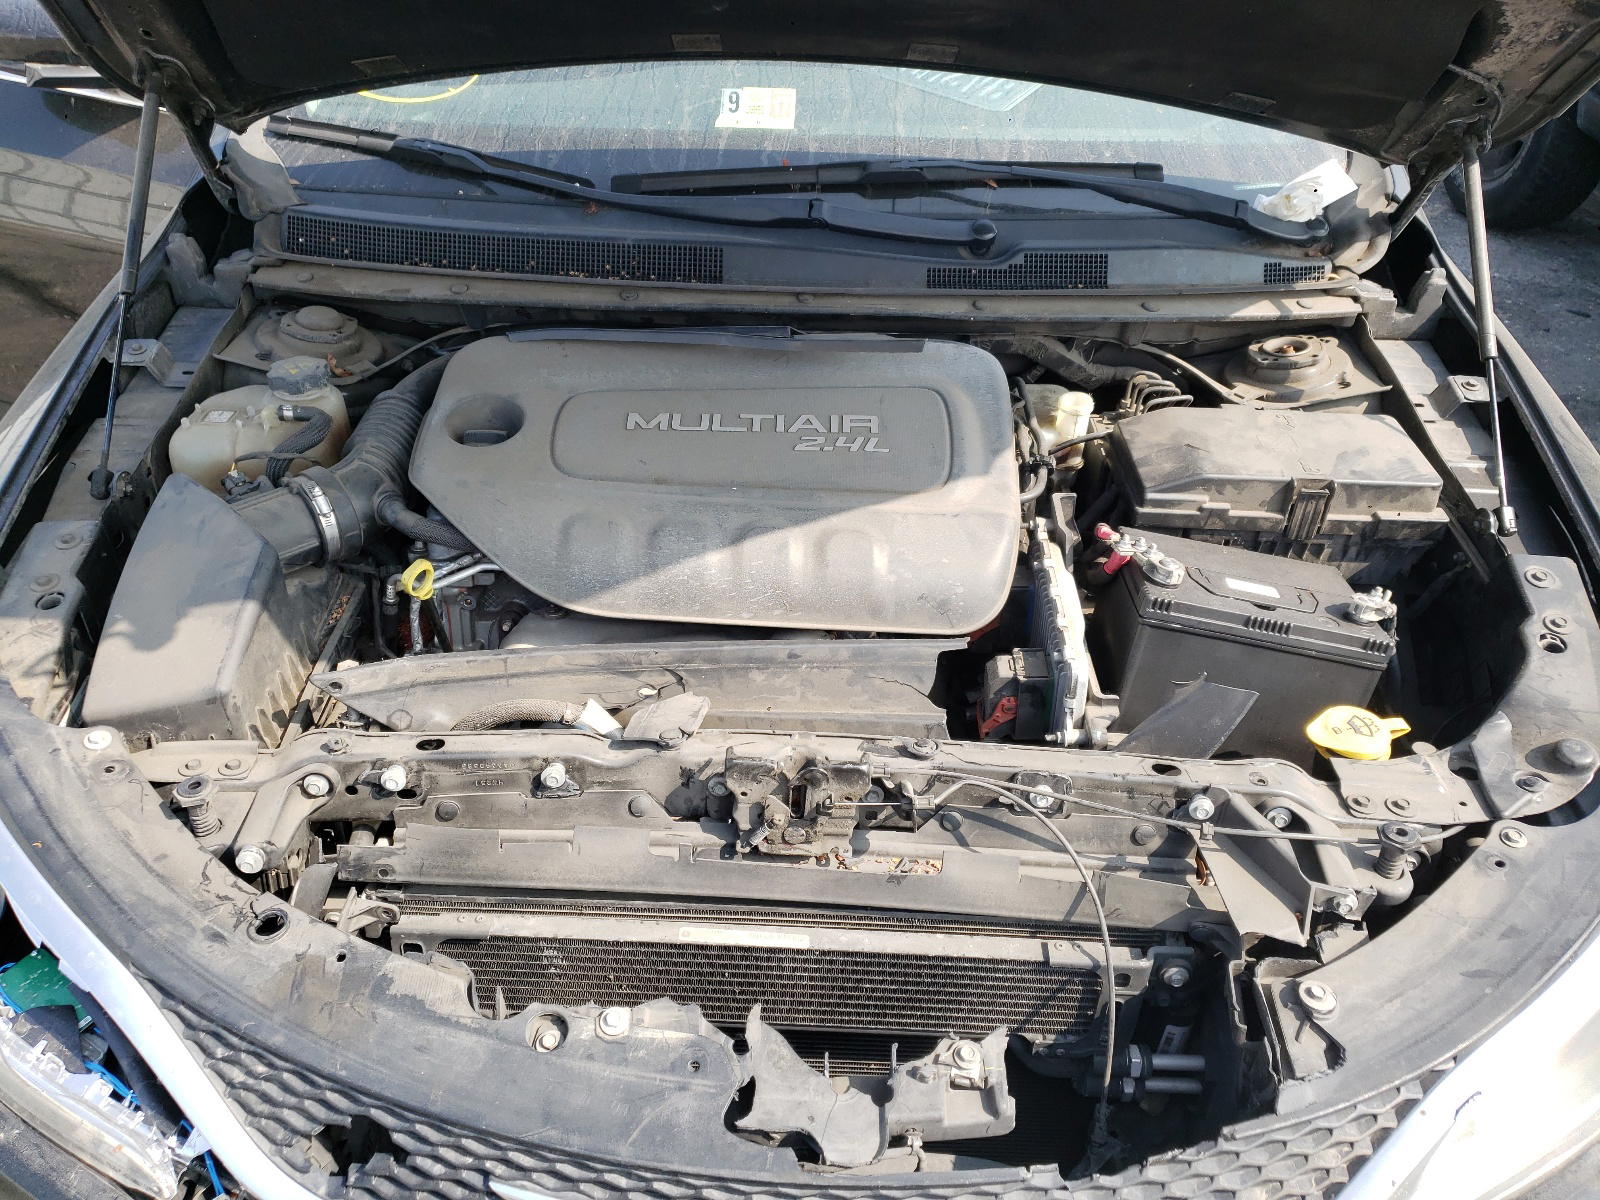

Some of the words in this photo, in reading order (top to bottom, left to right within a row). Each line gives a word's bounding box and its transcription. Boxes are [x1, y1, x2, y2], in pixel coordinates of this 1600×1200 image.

[728, 91, 740, 113] 9
[626, 412, 880, 434] MULTIAIR
[793, 436, 890, 452] 2.4L
